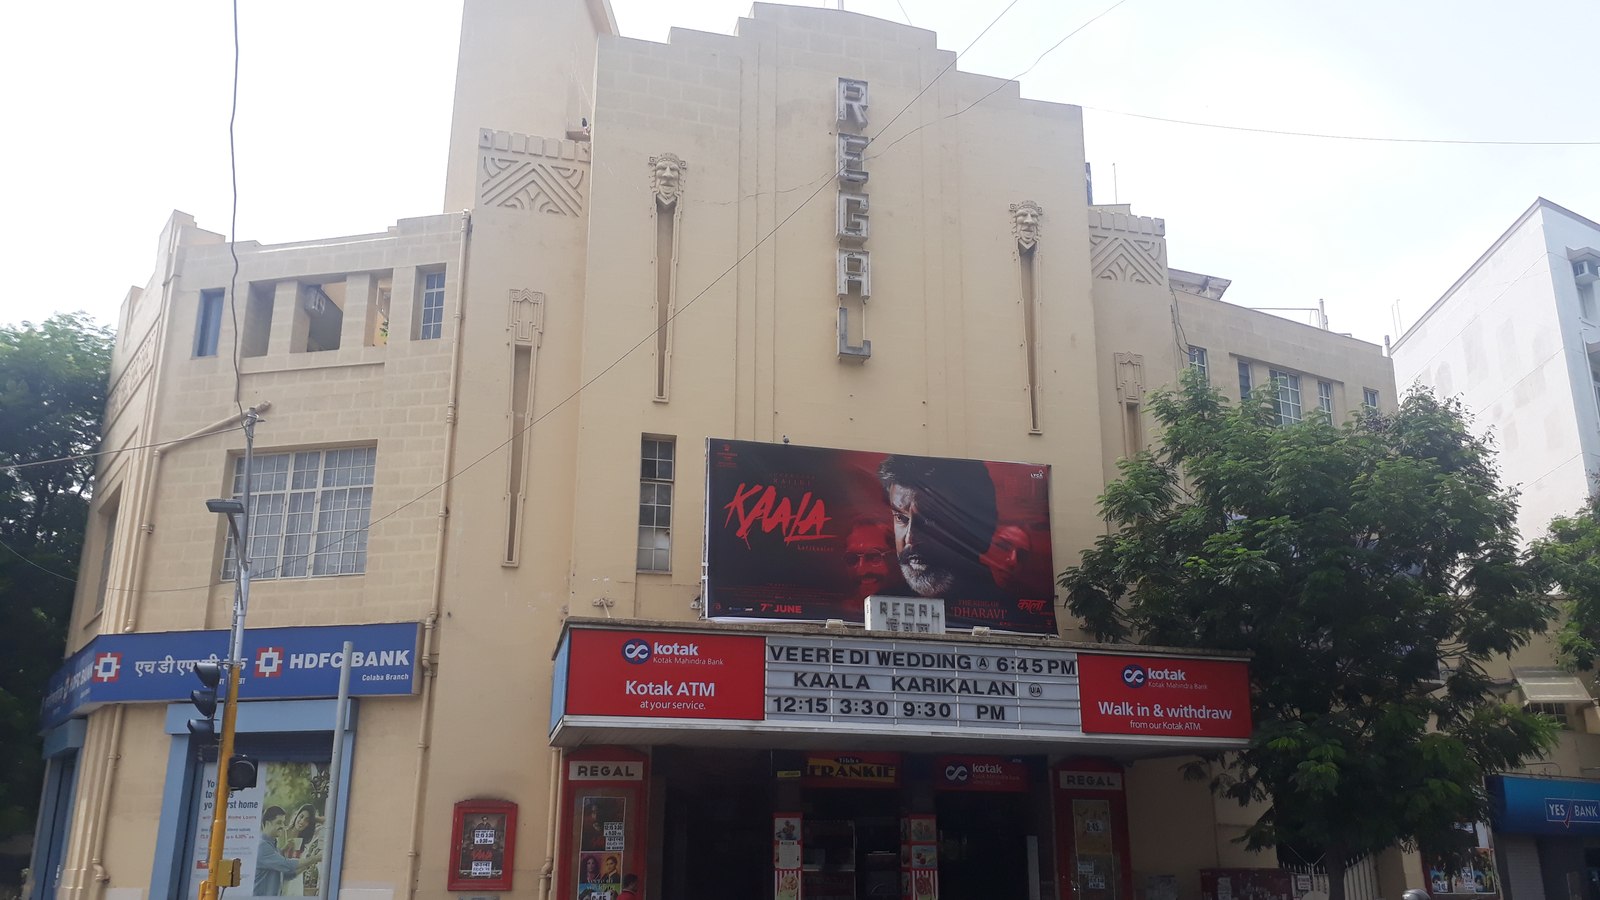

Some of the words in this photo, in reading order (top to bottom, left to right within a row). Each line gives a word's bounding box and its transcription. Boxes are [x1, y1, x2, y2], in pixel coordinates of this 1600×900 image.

[836, 76, 871, 363] REGAL
[723, 482, 837, 550] KAALA
[774, 604, 802, 614] JUNE
[880, 601, 940, 618] REGAL
[654, 642, 699, 656] kotak
[290, 652, 344, 669] HDFC
[351, 650, 410, 667] BANK
[770, 646, 844, 664] VEERE
[850, 650, 870, 665] DI
[877, 651, 971, 670] WEDDING
[386, 673, 409, 681] Branch
[1148, 667, 1186, 681] kotak
[625, 680, 673, 696] Kotak
[676, 681, 715, 697] ATM
[794, 672, 870, 690] KAALA
[892, 676, 1015, 696] KARIKALAN
[640, 700, 649, 709] at
[650, 701, 671, 711] your
[672, 701, 706, 710] service.
[773, 697, 828, 714] 12:15
[839, 699, 889, 716] 3:30
[903, 701, 951, 718] 9:30
[976, 705, 1005, 721] PM
[1098, 701, 1134, 717] Walk
[1137, 703, 1150, 717] in
[1153, 704, 1164, 718] &
[1166, 704, 1232, 720] withdraw
[1130, 720, 1148, 729] from
[1162, 722, 1184, 731] Kotak
[577, 766, 634, 776] REGAL
[972, 763, 1002, 774] kotak
[1066, 775, 1115, 786] REGAL
[238, 800, 259, 809] home
[1549, 804, 1566, 817] YES
[1574, 806, 1598, 817] BANK
